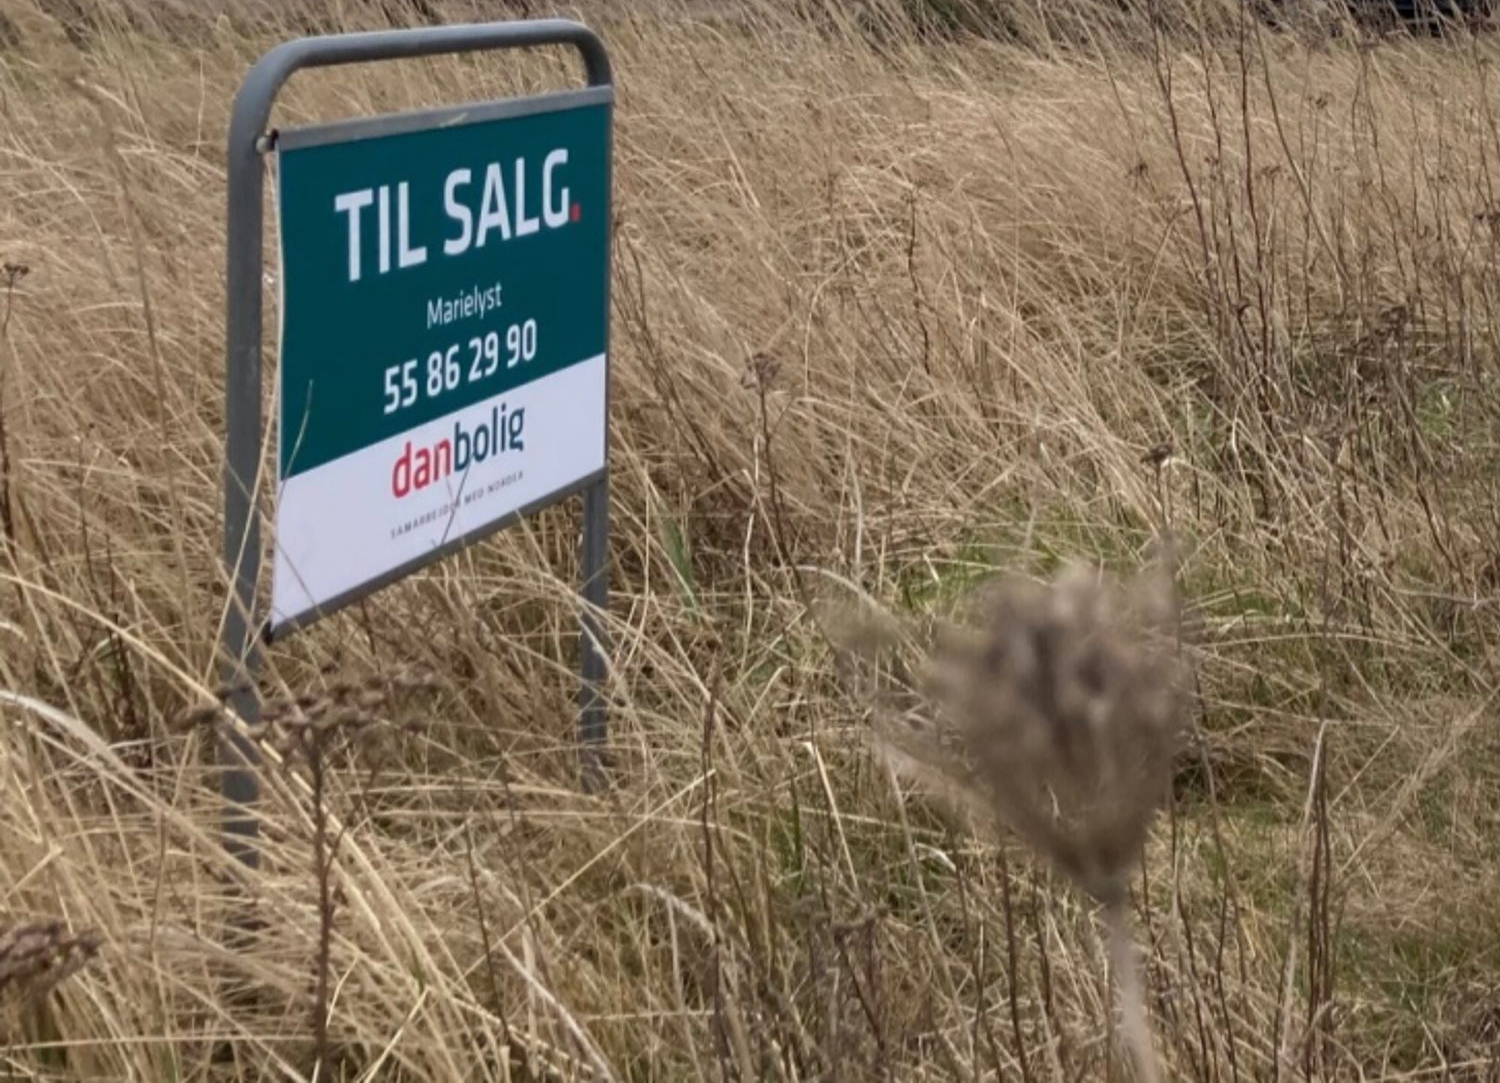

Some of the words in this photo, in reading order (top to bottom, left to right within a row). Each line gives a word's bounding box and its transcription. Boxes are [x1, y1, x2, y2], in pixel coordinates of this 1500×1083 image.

[334, 181, 427, 282] TIL
[443, 147, 581, 256] SALG.
[426, 282, 503, 329] Marielyst
[384, 358, 418, 415] 55
[426, 343, 460, 397] 86
[468, 331, 499, 383] 29
[507, 317, 537, 368] 90
[392, 402, 526, 498] danbolig
